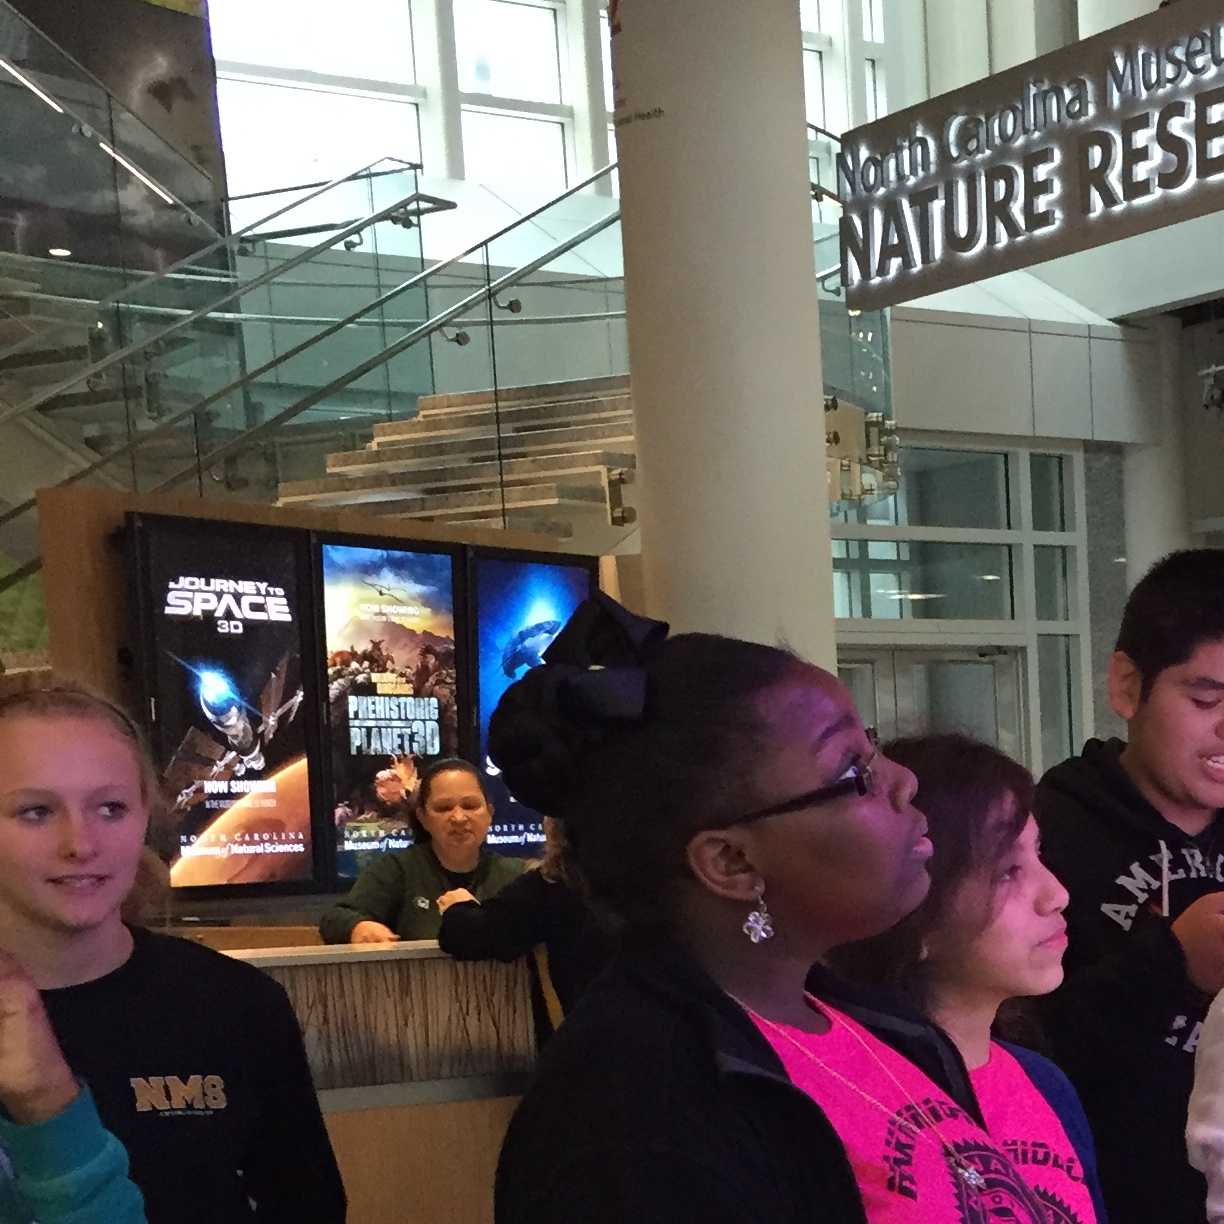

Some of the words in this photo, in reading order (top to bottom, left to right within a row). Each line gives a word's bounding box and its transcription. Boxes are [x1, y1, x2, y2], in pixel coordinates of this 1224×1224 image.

[837, 122, 934, 201] North
[944, 77, 1092, 163] Carolina
[839, 147, 1062, 288] NATURE
[169, 576, 268, 595] JOURNEY
[267, 586, 285, 596] TO
[164, 591, 292, 621] SPACE
[217, 620, 243, 634] 3D
[348, 695, 440, 720] PREHISTORIC
[350, 727, 412, 756] PLANET
[411, 720, 441, 756] 3D
[204, 780, 229, 794] NOW
[230, 780, 277, 793] SHOWING
[231, 842, 264, 854] Natural
[264, 841, 305, 853] Sciences
[235, 831, 304, 842] CAROLINA
